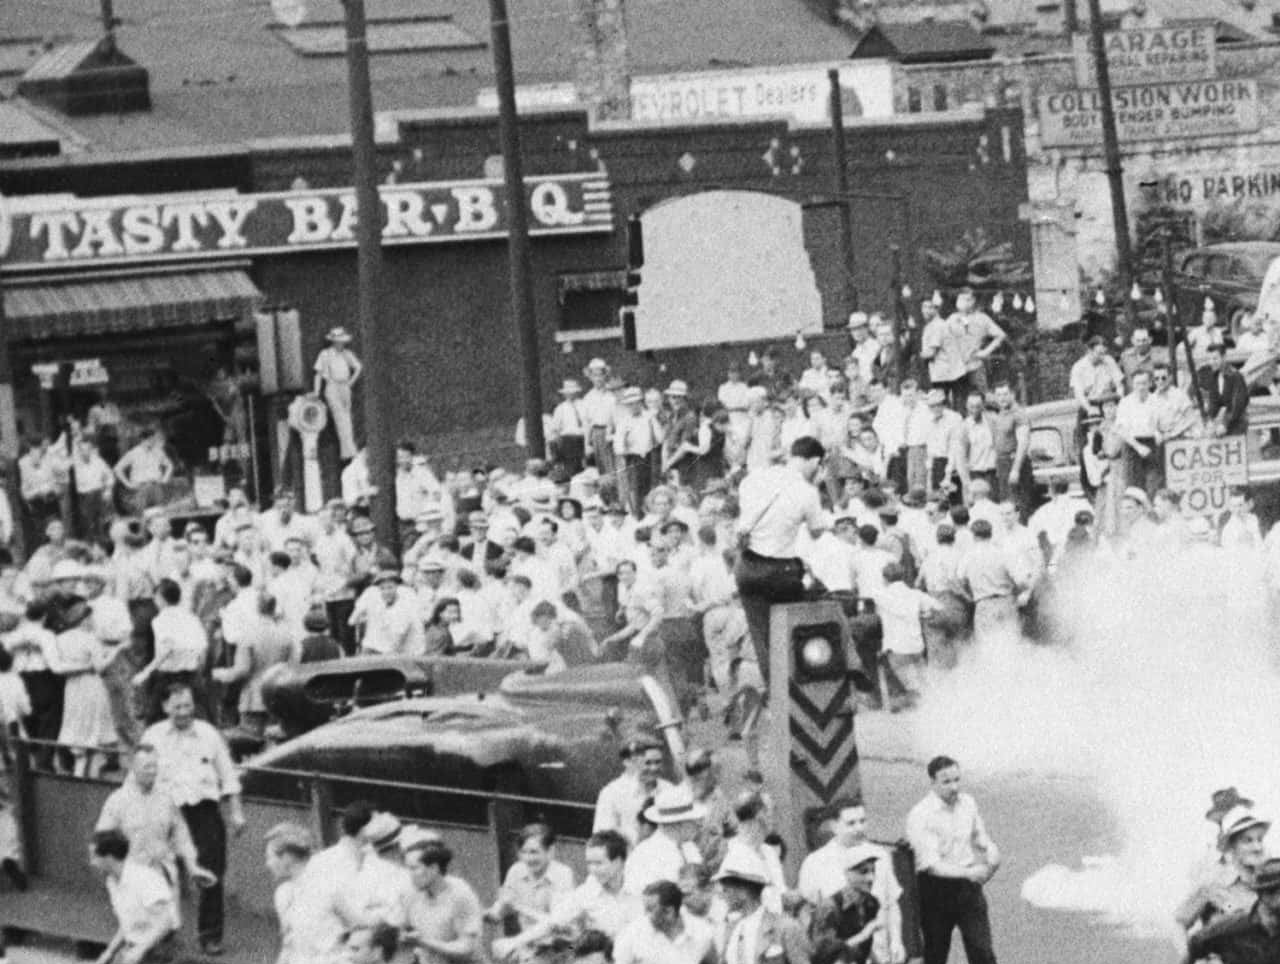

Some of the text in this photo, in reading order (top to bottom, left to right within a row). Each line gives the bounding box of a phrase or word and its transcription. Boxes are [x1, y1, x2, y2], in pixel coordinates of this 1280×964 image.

[1048, 82, 1250, 113] COLLSION WORK
[1062, 103, 1235, 128] BODY ENDER BUMPING
[30, 200, 257, 260] TASTY
[1170, 442, 1242, 470] CASH
